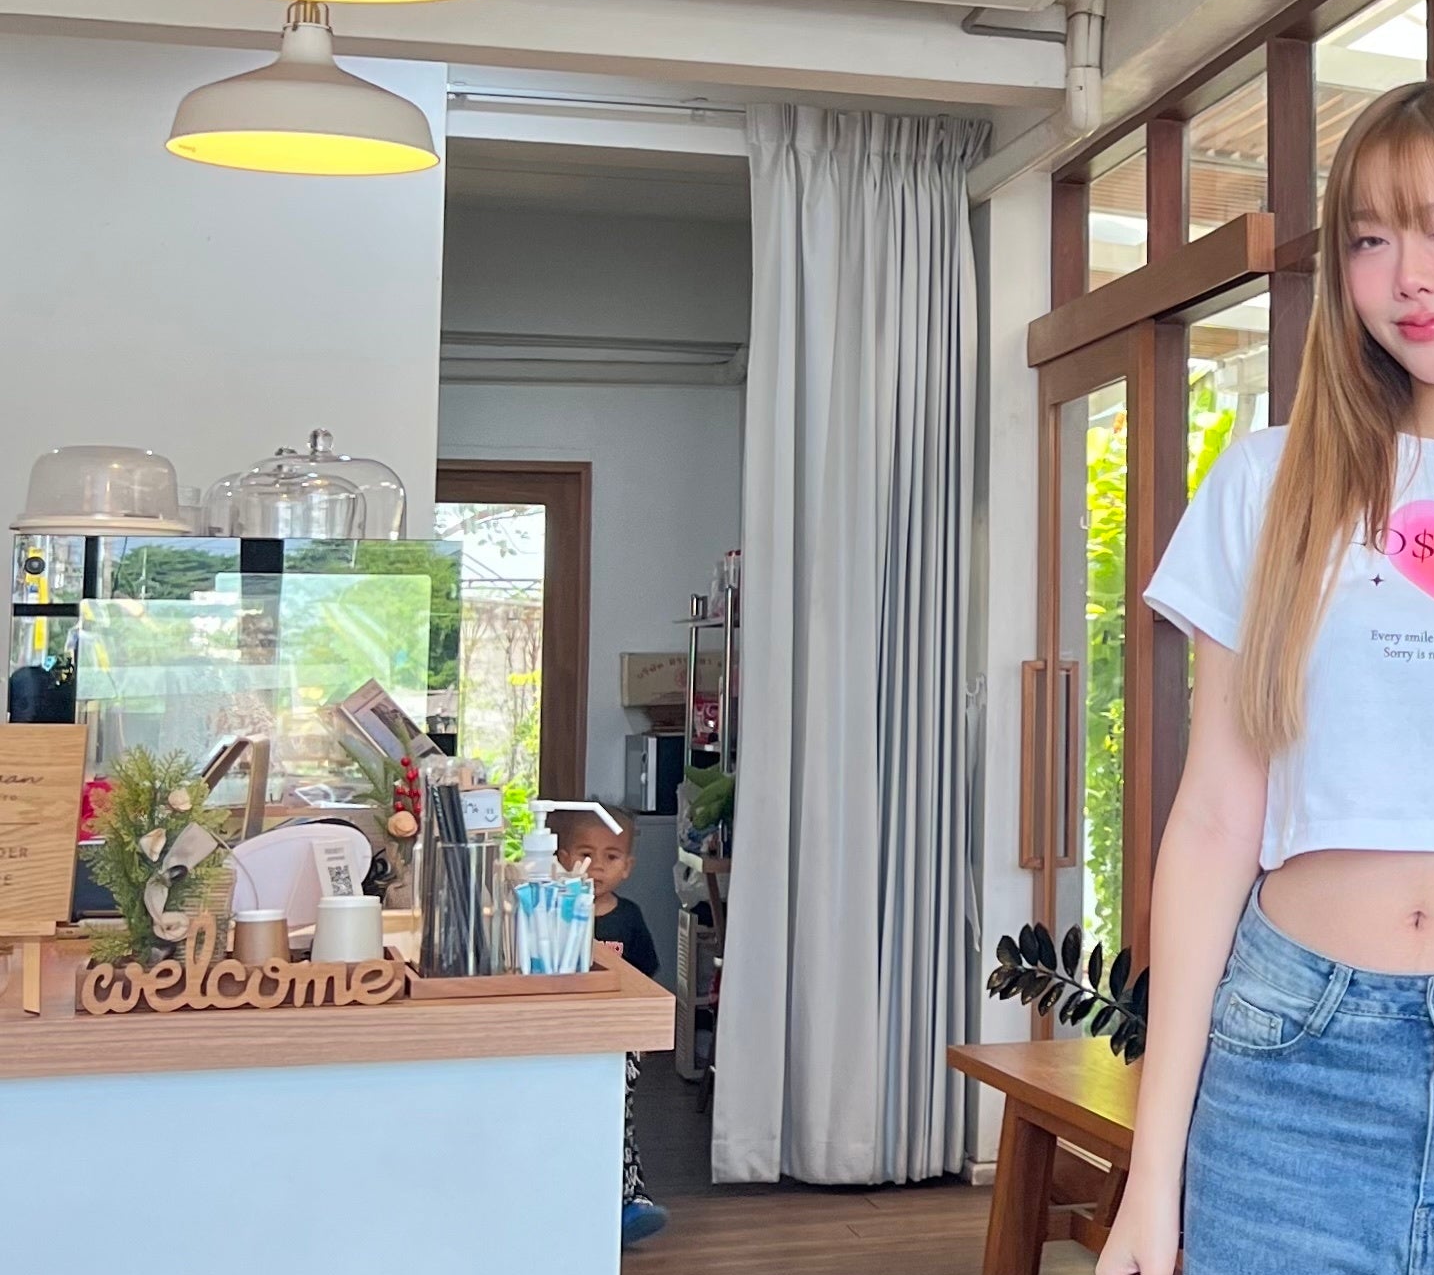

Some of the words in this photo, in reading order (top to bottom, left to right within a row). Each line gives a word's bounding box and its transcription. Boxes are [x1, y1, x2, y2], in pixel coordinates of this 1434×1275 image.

[1371, 629, 1402, 645] Every
[1404, 630, 1434, 643] smile
[1383, 646, 1414, 663] Sorry
[1416, 649, 1426, 660] is
[82, 909, 404, 1015] welcome
